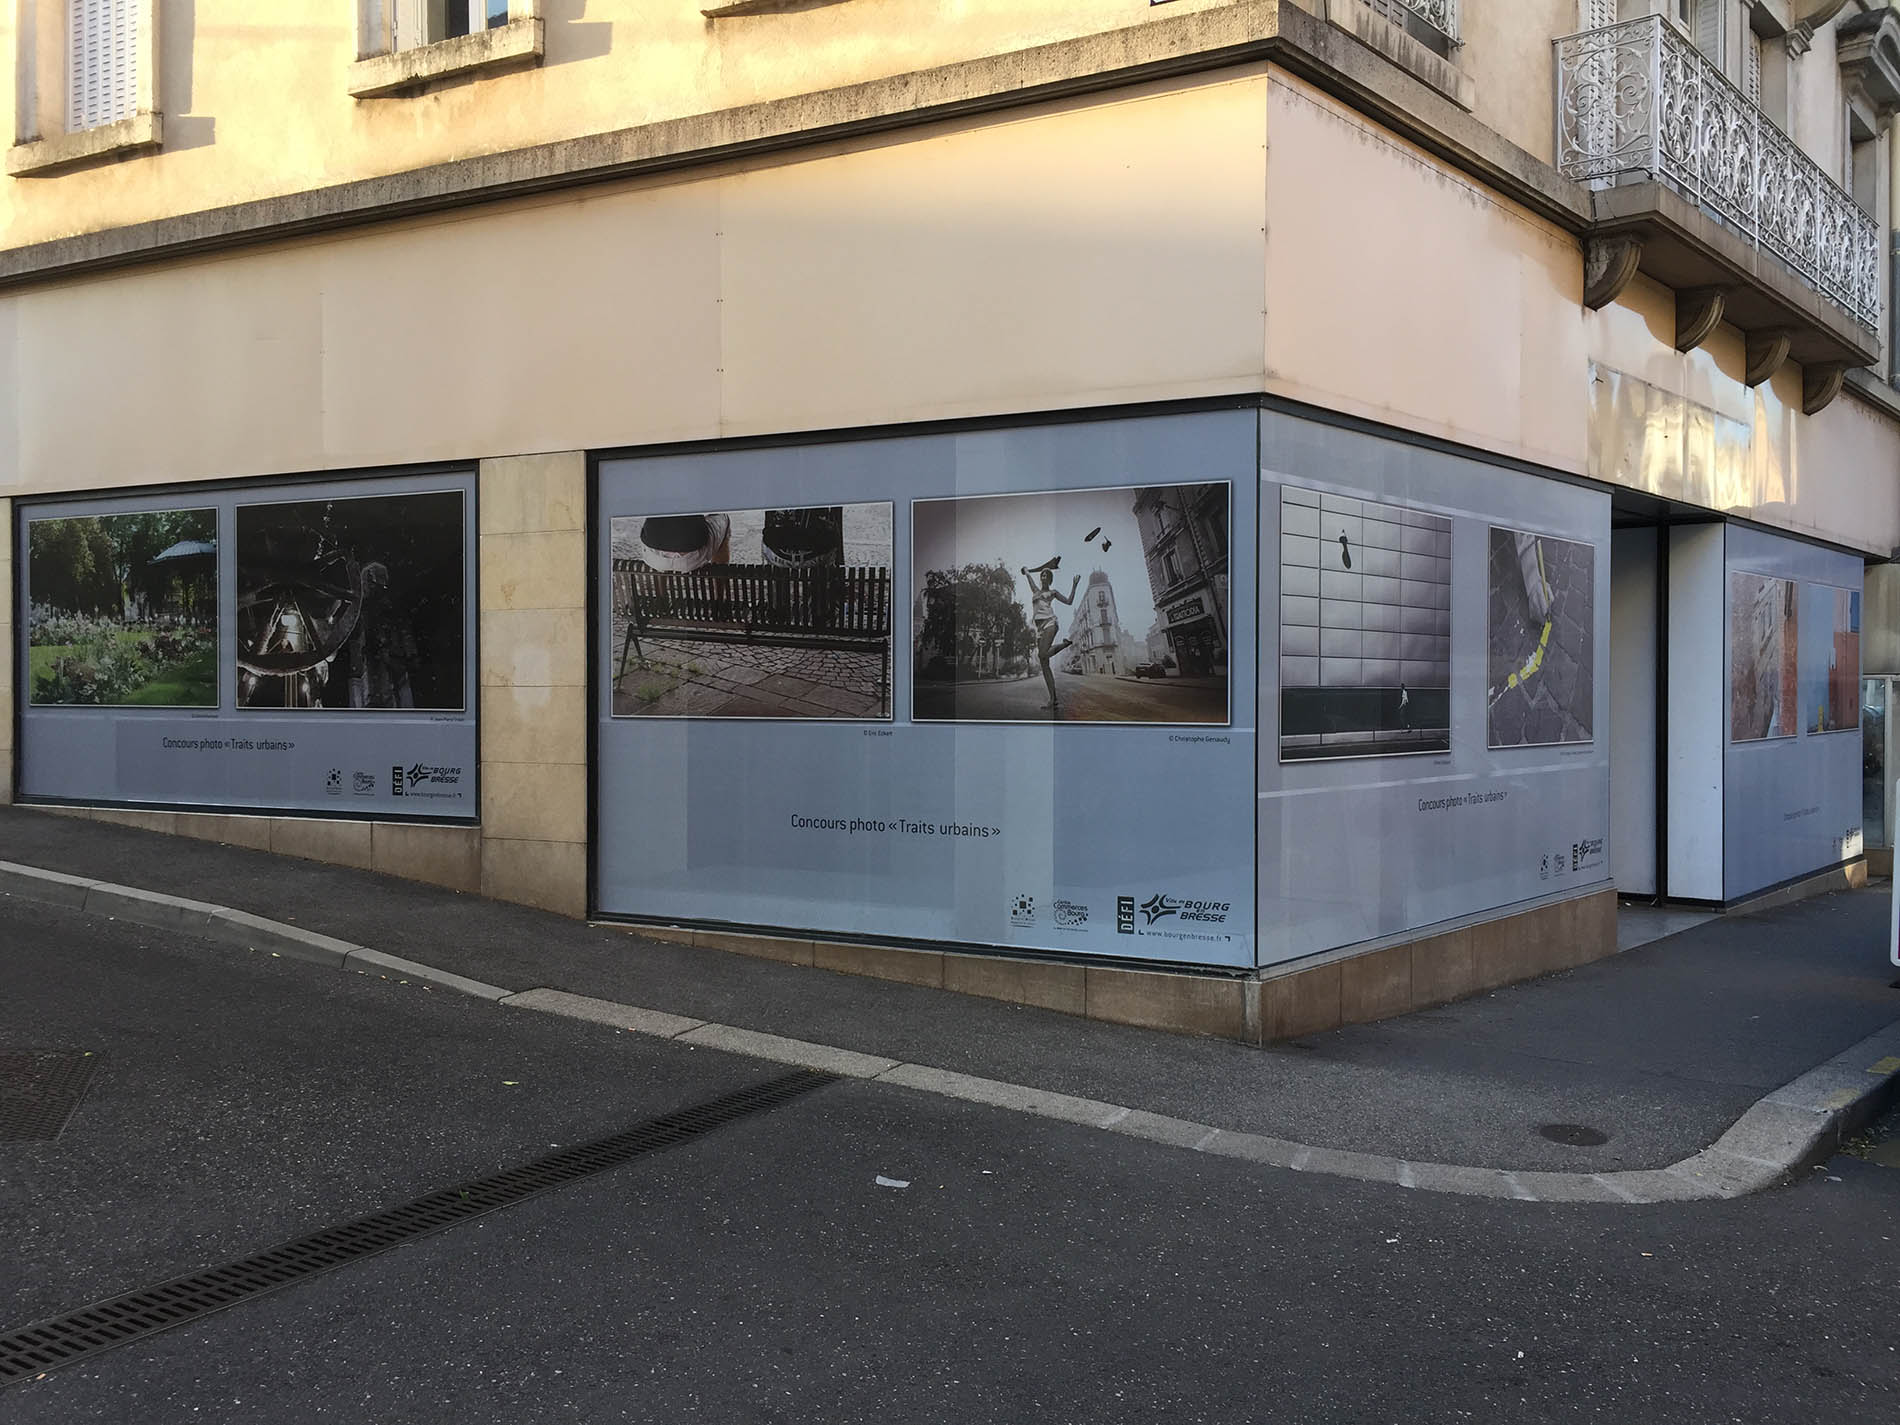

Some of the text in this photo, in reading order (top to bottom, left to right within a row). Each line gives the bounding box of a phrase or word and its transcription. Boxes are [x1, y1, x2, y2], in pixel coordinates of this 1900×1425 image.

[162, 736, 199, 749] Concours
[200, 739, 223, 752] photo
[433, 767, 462, 776] BOURG
[1418, 798, 1446, 812] Concours
[1446, 795, 1463, 812] photo
[791, 814, 847, 830] Concours
[849, 817, 886, 835] photo
[1184, 900, 1231, 912] BOURG
[1118, 900, 1134, 931] DÉFI
[1180, 911, 1227, 923] BRESSE
